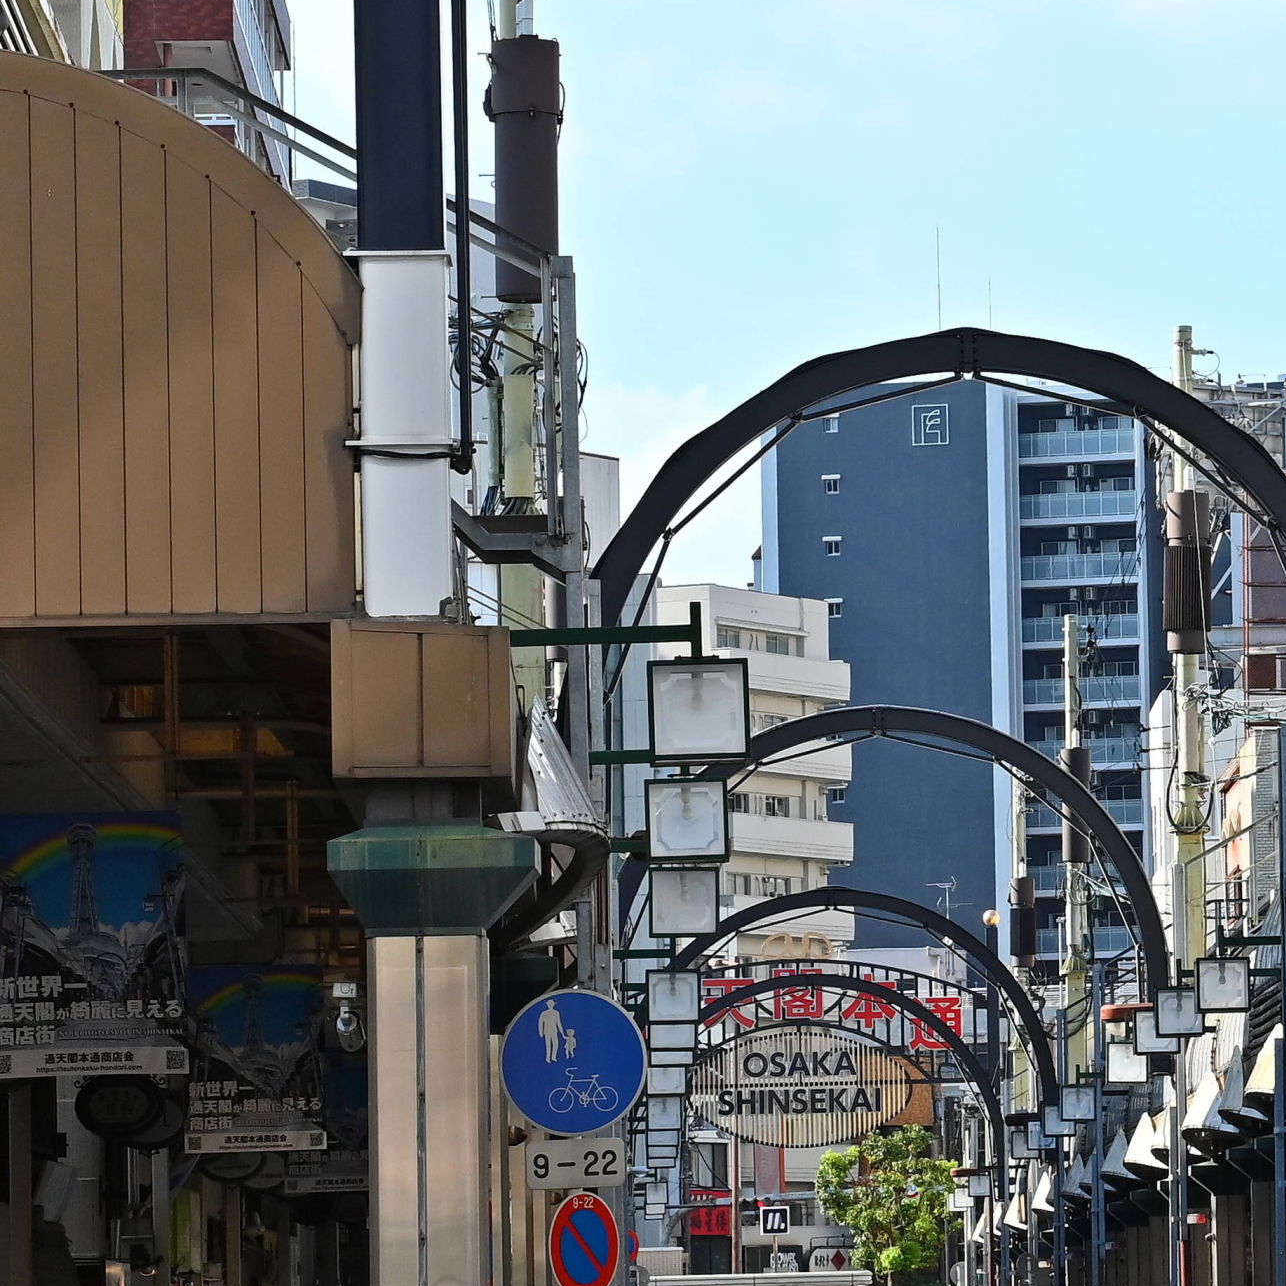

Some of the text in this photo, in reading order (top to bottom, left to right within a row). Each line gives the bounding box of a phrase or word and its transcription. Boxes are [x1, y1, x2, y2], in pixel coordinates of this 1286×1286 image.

[44, 1051, 135, 1065] 通天閣本通商店会
[742, 1051, 858, 1078] OSAKA
[718, 1087, 881, 1116] SHINSEKAI
[572, 1196, 594, 1209] 9-22
